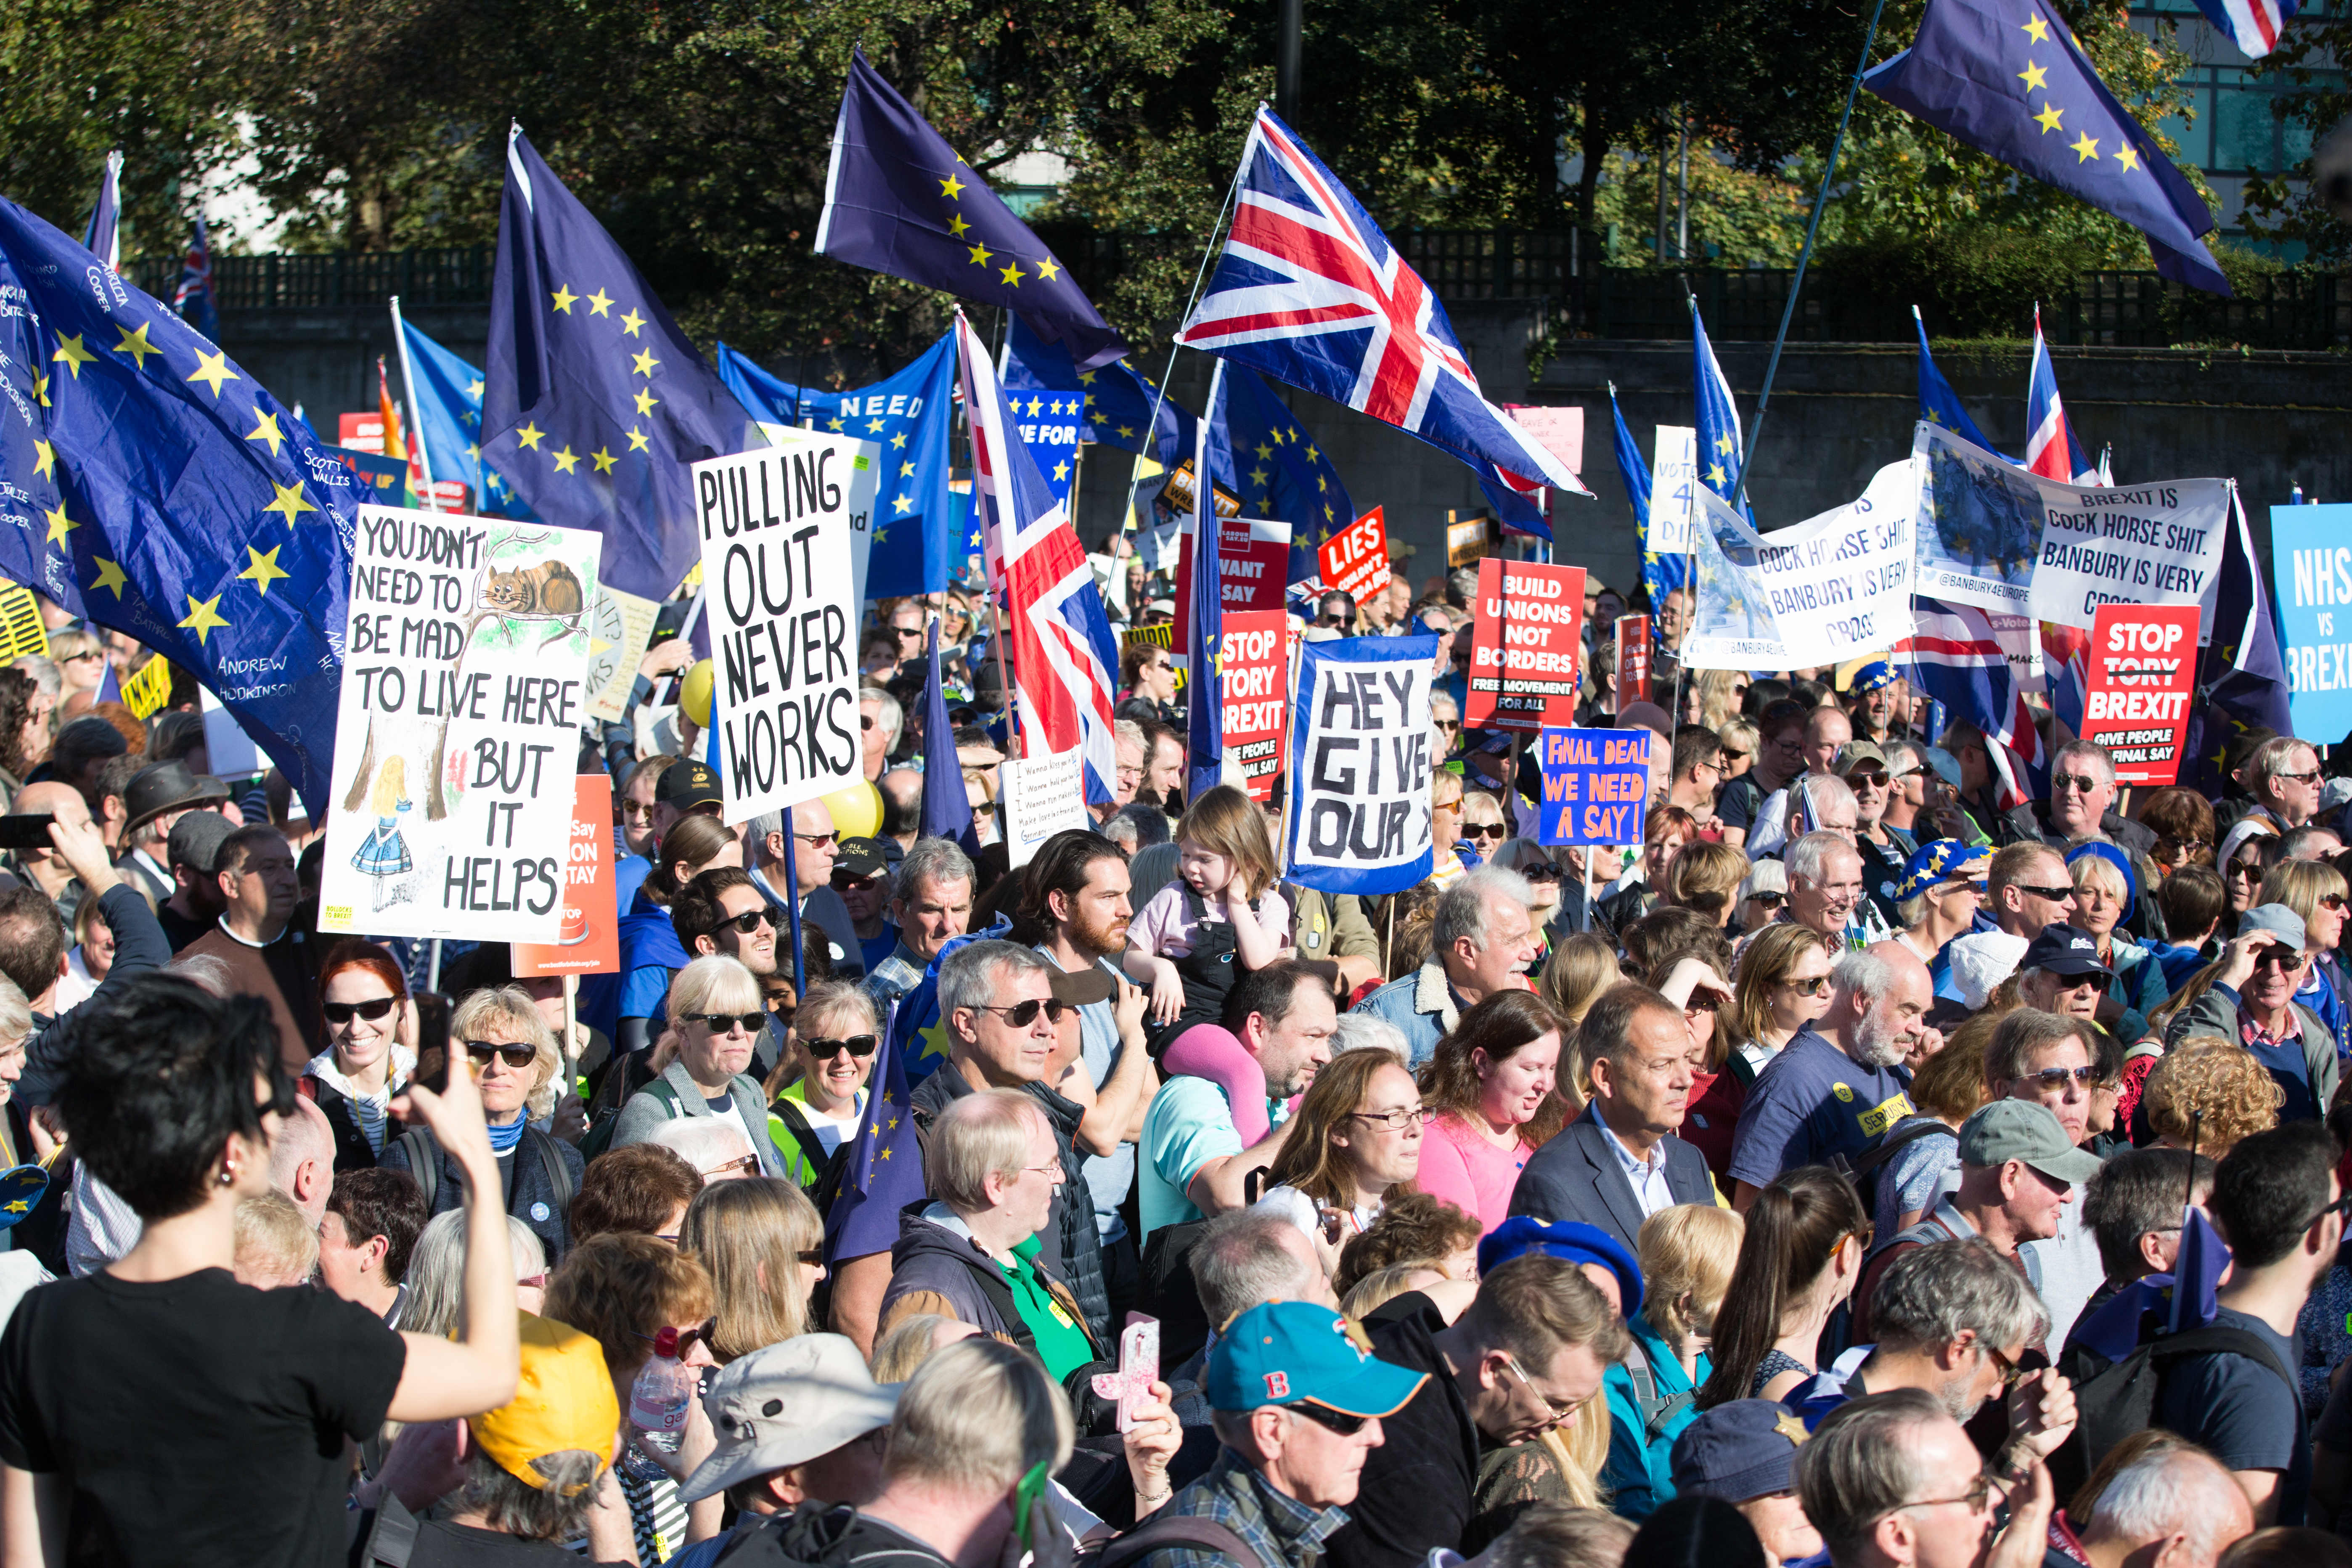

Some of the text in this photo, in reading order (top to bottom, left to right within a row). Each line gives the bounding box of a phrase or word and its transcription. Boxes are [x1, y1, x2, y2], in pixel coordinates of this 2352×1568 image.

[0, 284, 26, 302] ARAH
[87, 266, 111, 314] COOPER
[0, 370, 33, 428] ODKINSON
[841, 395, 923, 418] NEED
[1038, 425, 1077, 445] FOR
[304, 447, 342, 472] SCOTT
[312, 468, 351, 487] WALLIS
[376, 474, 395, 489] UP
[699, 448, 841, 540] PULLING
[1175, 472, 1235, 516] BRIT
[1672, 483, 1692, 515] 4
[2080, 488, 2179, 509] BREXIT IS
[0, 514, 32, 530] OOPER
[2048, 509, 2207, 556] COCK HORSE SHIT.
[363, 516, 486, 569] YOU DON'T
[1328, 518, 1380, 575] LIES
[1759, 517, 1908, 575] COCK HORSE SHIT.
[723, 524, 819, 627] OUT
[2042, 540, 2204, 594] BANBURY IS VERY
[2292, 547, 2352, 607] NHS
[355, 565, 461, 613] NEED TO
[1221, 584, 1256, 603] SAY
[1502, 575, 1562, 599] BUILD
[1770, 558, 1908, 615] BANBURY IS VERY
[1939, 572, 2030, 602] @BANBURY4EUROPE
[1486, 599, 1572, 625] UNIONS
[2317, 612, 2334, 637] VS
[352, 613, 464, 660] BE MAD
[1222, 630, 1276, 662] STOP
[1504, 625, 1552, 647] NOT
[2107, 622, 2183, 652] STOP
[219, 656, 287, 676] ANDREW
[723, 604, 848, 708] NEVER
[1475, 646, 1572, 674] BORDERS
[1624, 655, 1647, 670] OPTION
[2284, 644, 2352, 694] BREX
[1221, 665, 1277, 698] TORY
[2103, 657, 2181, 686] TORY
[220, 683, 296, 701] HODKINSON
[356, 667, 580, 728] TO LIVE HERE
[1320, 669, 1414, 730] HEY
[1471, 678, 1573, 696] FREE MOVEMENT
[1497, 697, 1545, 712] FOR ALL
[2087, 691, 2188, 720] BREXIT
[726, 688, 855, 801] WORKS
[1242, 739, 1276, 759] PEOPLE
[1548, 734, 1650, 766] FINAL DEAL
[2093, 728, 2172, 746] GIVE PEOPLE
[471, 737, 554, 798] BUT
[1016, 762, 1021, 779] I
[1025, 765, 1047, 776] Wanna
[1049, 759, 1060, 769] kiss
[1260, 758, 1278, 774] SAY
[1311, 731, 1427, 796] GIVE
[2112, 746, 2175, 763] FINAL SAY
[1017, 782, 1022, 795] I
[1026, 783, 1047, 793] Wanna
[1050, 776, 1059, 787] hold
[1542, 773, 1645, 802] WE NEED
[1015, 799, 1022, 812] I
[1025, 800, 1046, 810] Wanna
[1048, 797, 1057, 805] run
[487, 801, 523, 848] IT
[1019, 817, 1036, 828] Make
[1039, 813, 1050, 823] love
[1307, 797, 1411, 860] OUR
[1556, 806, 1573, 838] A
[443, 855, 558, 916] HELPS
[538, 959, 600, 969] www.bestforbritain.org/join
[1262, 1371, 1291, 1399] B
